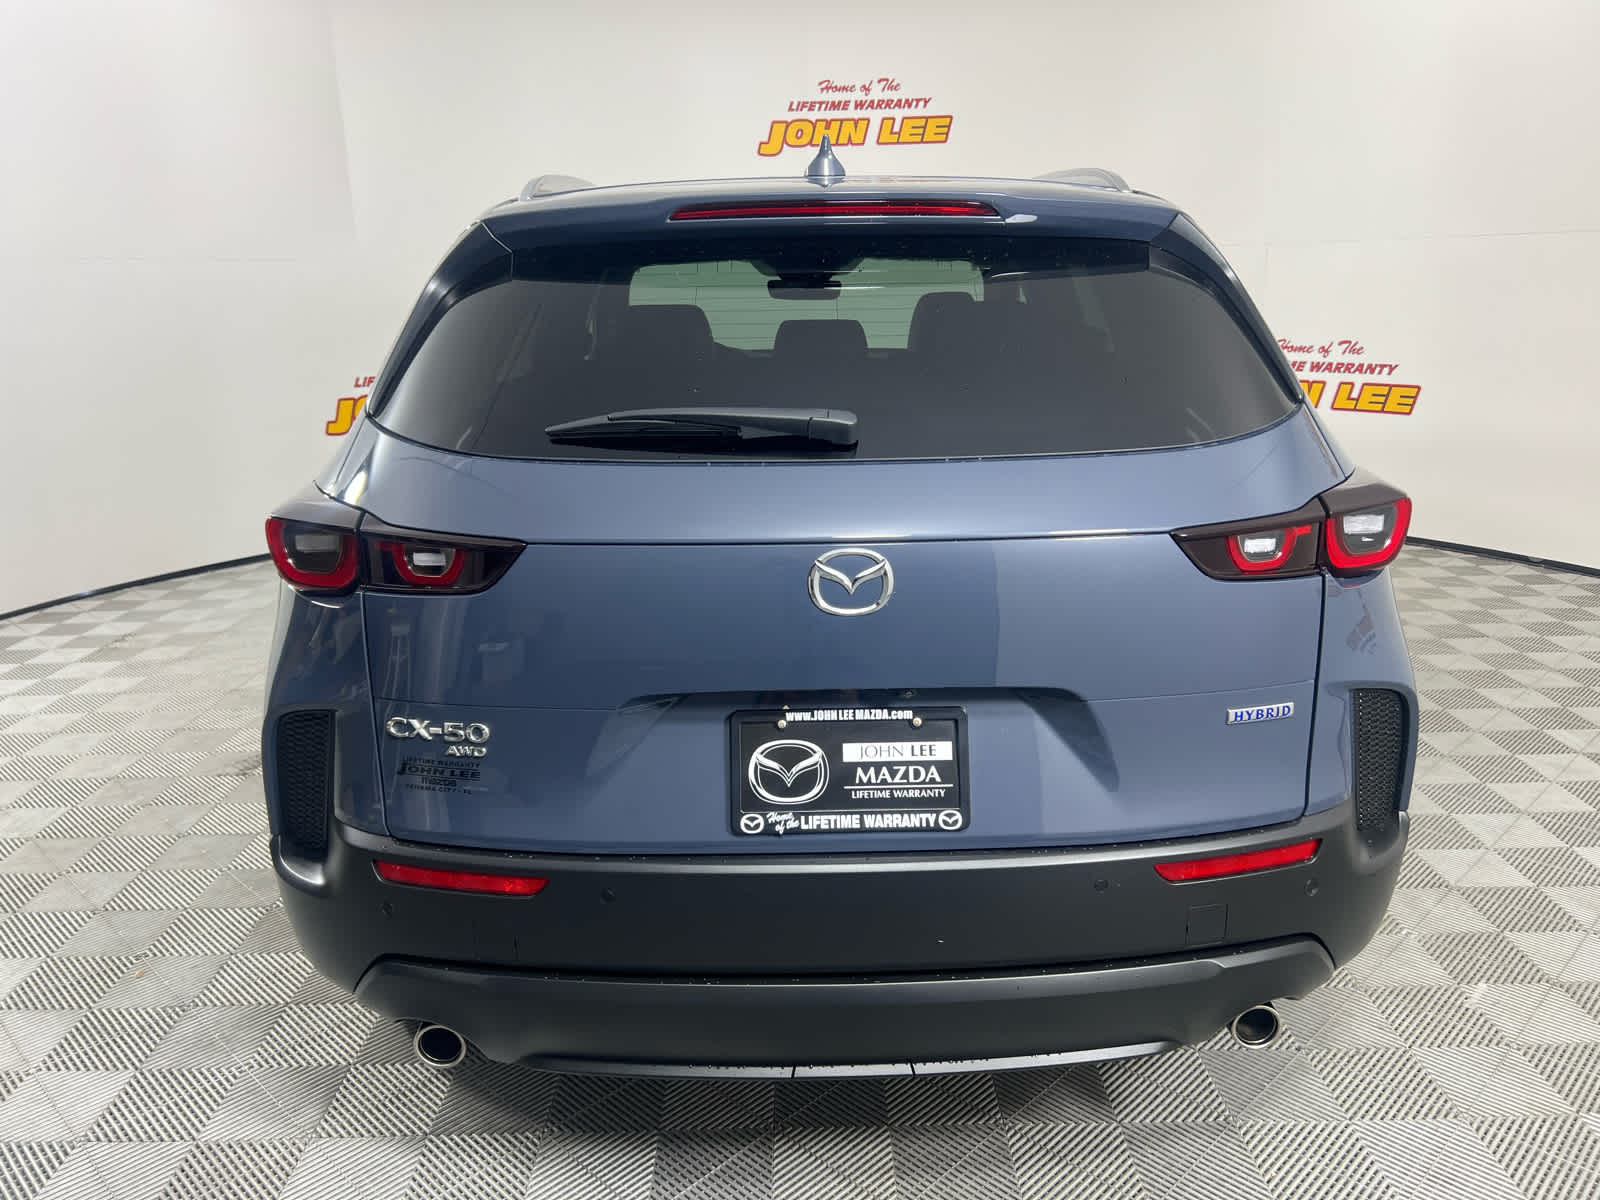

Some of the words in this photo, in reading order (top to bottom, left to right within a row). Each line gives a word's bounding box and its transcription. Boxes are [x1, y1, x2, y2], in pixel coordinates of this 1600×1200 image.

[818, 79, 856, 94] Home
[859, 80, 874, 97] of
[877, 77, 901, 93] The
[787, 100, 850, 112] LIFETIME
[854, 97, 932, 110] WARRANTY
[757, 117, 870, 157] JOHN
[876, 115, 953, 145] LEE
[1318, 341, 1334, 358] of
[1338, 340, 1365, 355] The
[1310, 361, 1399, 376] WARRANTY
[1330, 381, 1422, 416] LEE
[786, 710, 838, 721] www.JOHN
[839, 710, 854, 721] LEE
[855, 710, 913, 720] MAZDA.com
[1233, 705, 1291, 722] HYBRID
[386, 716, 490, 744] CX-50
[446, 745, 488, 758] AWD
[860, 745, 904, 760] JOHN
[911, 744, 937, 757] LEE
[397, 762, 445, 776] JOHN
[449, 769, 481, 779] LEE
[855, 765, 942, 784] MAZDA
[852, 789, 891, 799] LIFETIME
[893, 788, 946, 798] WARRANTY
[766, 811, 793, 823] Home
[801, 815, 860, 829] LIFETIME
[864, 813, 936, 829] WARRANTY
[775, 820, 785, 834] of
[786, 818, 800, 829] the
